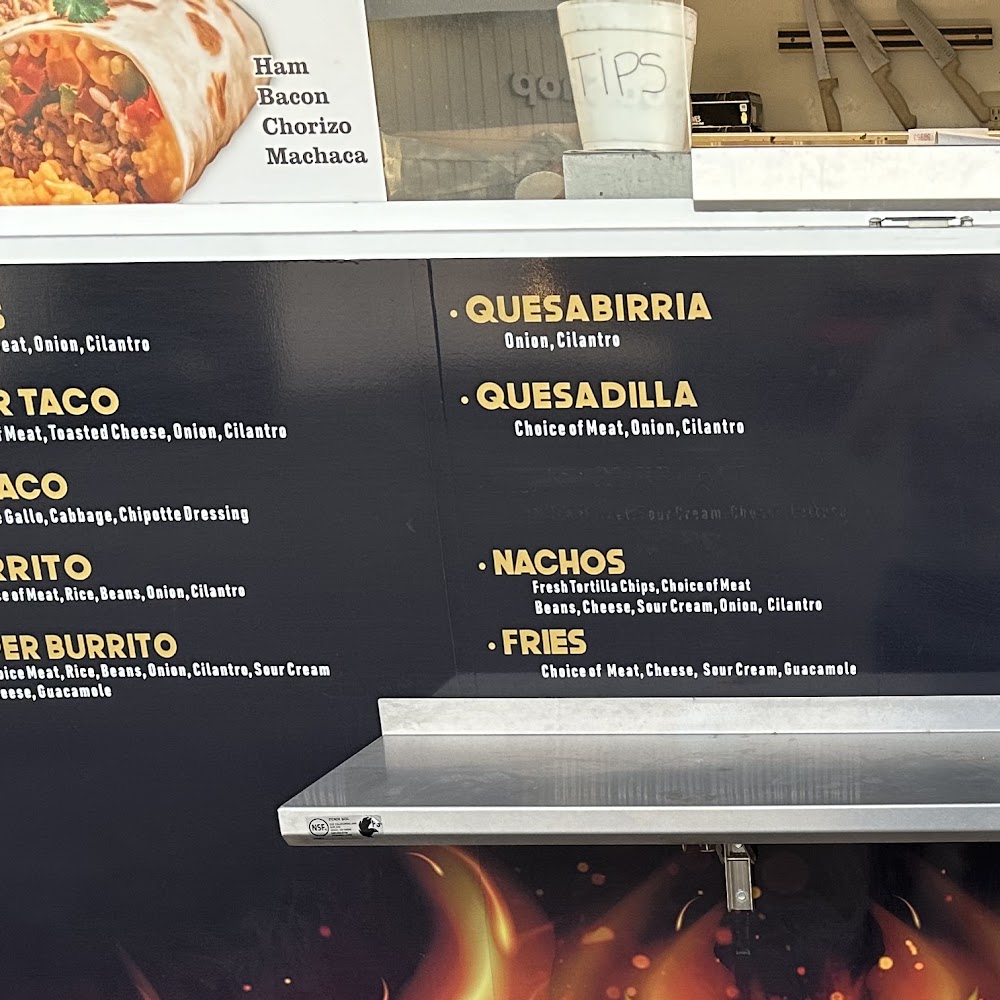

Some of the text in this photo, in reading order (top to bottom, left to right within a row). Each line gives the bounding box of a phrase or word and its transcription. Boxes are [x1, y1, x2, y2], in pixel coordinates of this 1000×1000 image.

[254, 58, 309, 74] Ham
[258, 88, 329, 105] Bacon
[263, 117, 351, 135] Chorizo
[266, 147, 367, 164] Machaca
[466, 292, 712, 323] QUESABIRRIA
[86, 335, 149, 351] Cilantro
[557, 331, 620, 348] Cilantro
[17, 388, 119, 415] TACO
[477, 381, 697, 409] QUESADILLA
[48, 424, 108, 440] Toasted
[224, 423, 286, 438] Cilantro
[515, 420, 565, 436] Choice
[569, 420, 583, 436] of
[682, 418, 744, 434] Cilantro
[183, 505, 249, 524] Dressing
[0, 555, 91, 581] RITO
[493, 549, 625, 575] NACHOS
[12, 588, 24, 601] of
[191, 584, 245, 598] Cilantro
[533, 580, 568, 593] Fresh
[569, 580, 617, 593] Tortilla
[662, 579, 703, 592] Choice
[706, 578, 718, 591] of
[720, 578, 750, 591] Meat
[637, 599, 667, 613] Sour
[768, 598, 822, 611] Cilantro
[0, 633, 177, 660] ER BURRITO
[502, 629, 586, 654] FRIES
[254, 662, 284, 676] Sour
[287, 662, 330, 676] Cream
[542, 664, 586, 678] Choice
[589, 664, 601, 677] of
[703, 663, 733, 676] Sour
[784, 662, 856, 675] Guacamole
[37, 683, 111, 698] Guacamole
